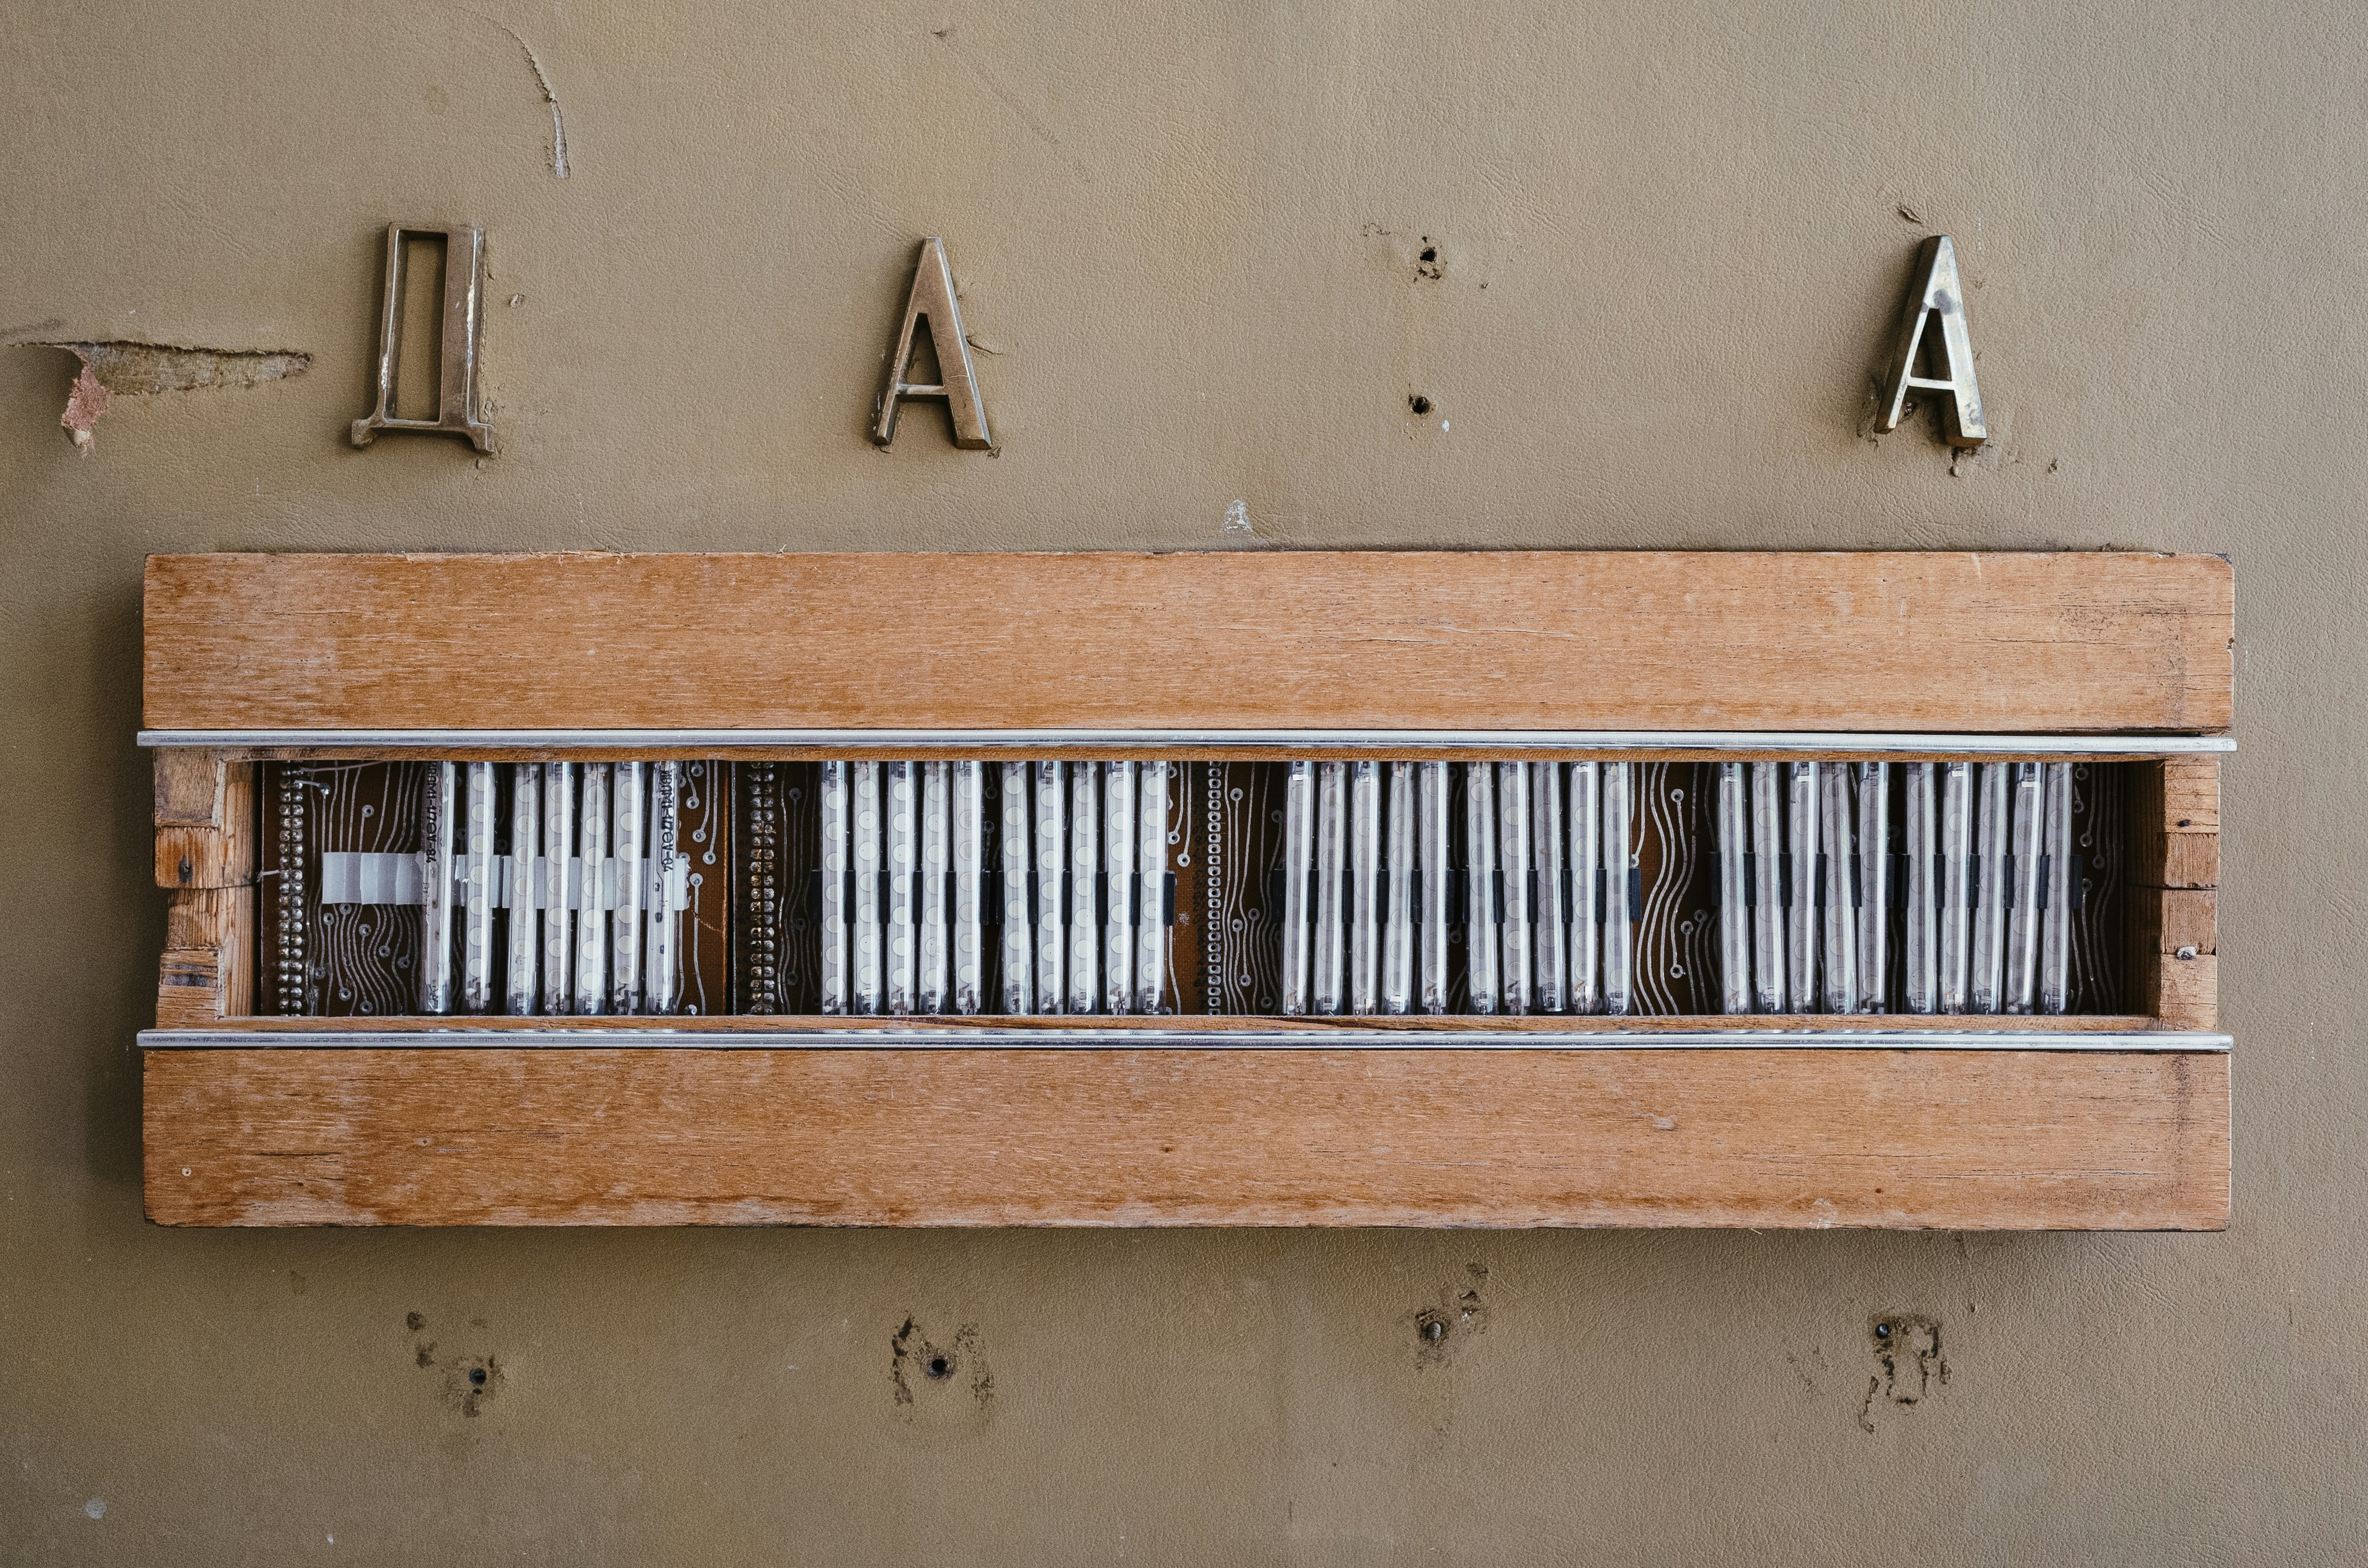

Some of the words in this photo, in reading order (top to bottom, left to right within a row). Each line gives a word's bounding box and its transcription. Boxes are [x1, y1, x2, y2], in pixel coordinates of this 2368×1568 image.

[350, 222, 495, 454] Д
[873, 237, 993, 450] А
[1873, 235, 1987, 446] А
